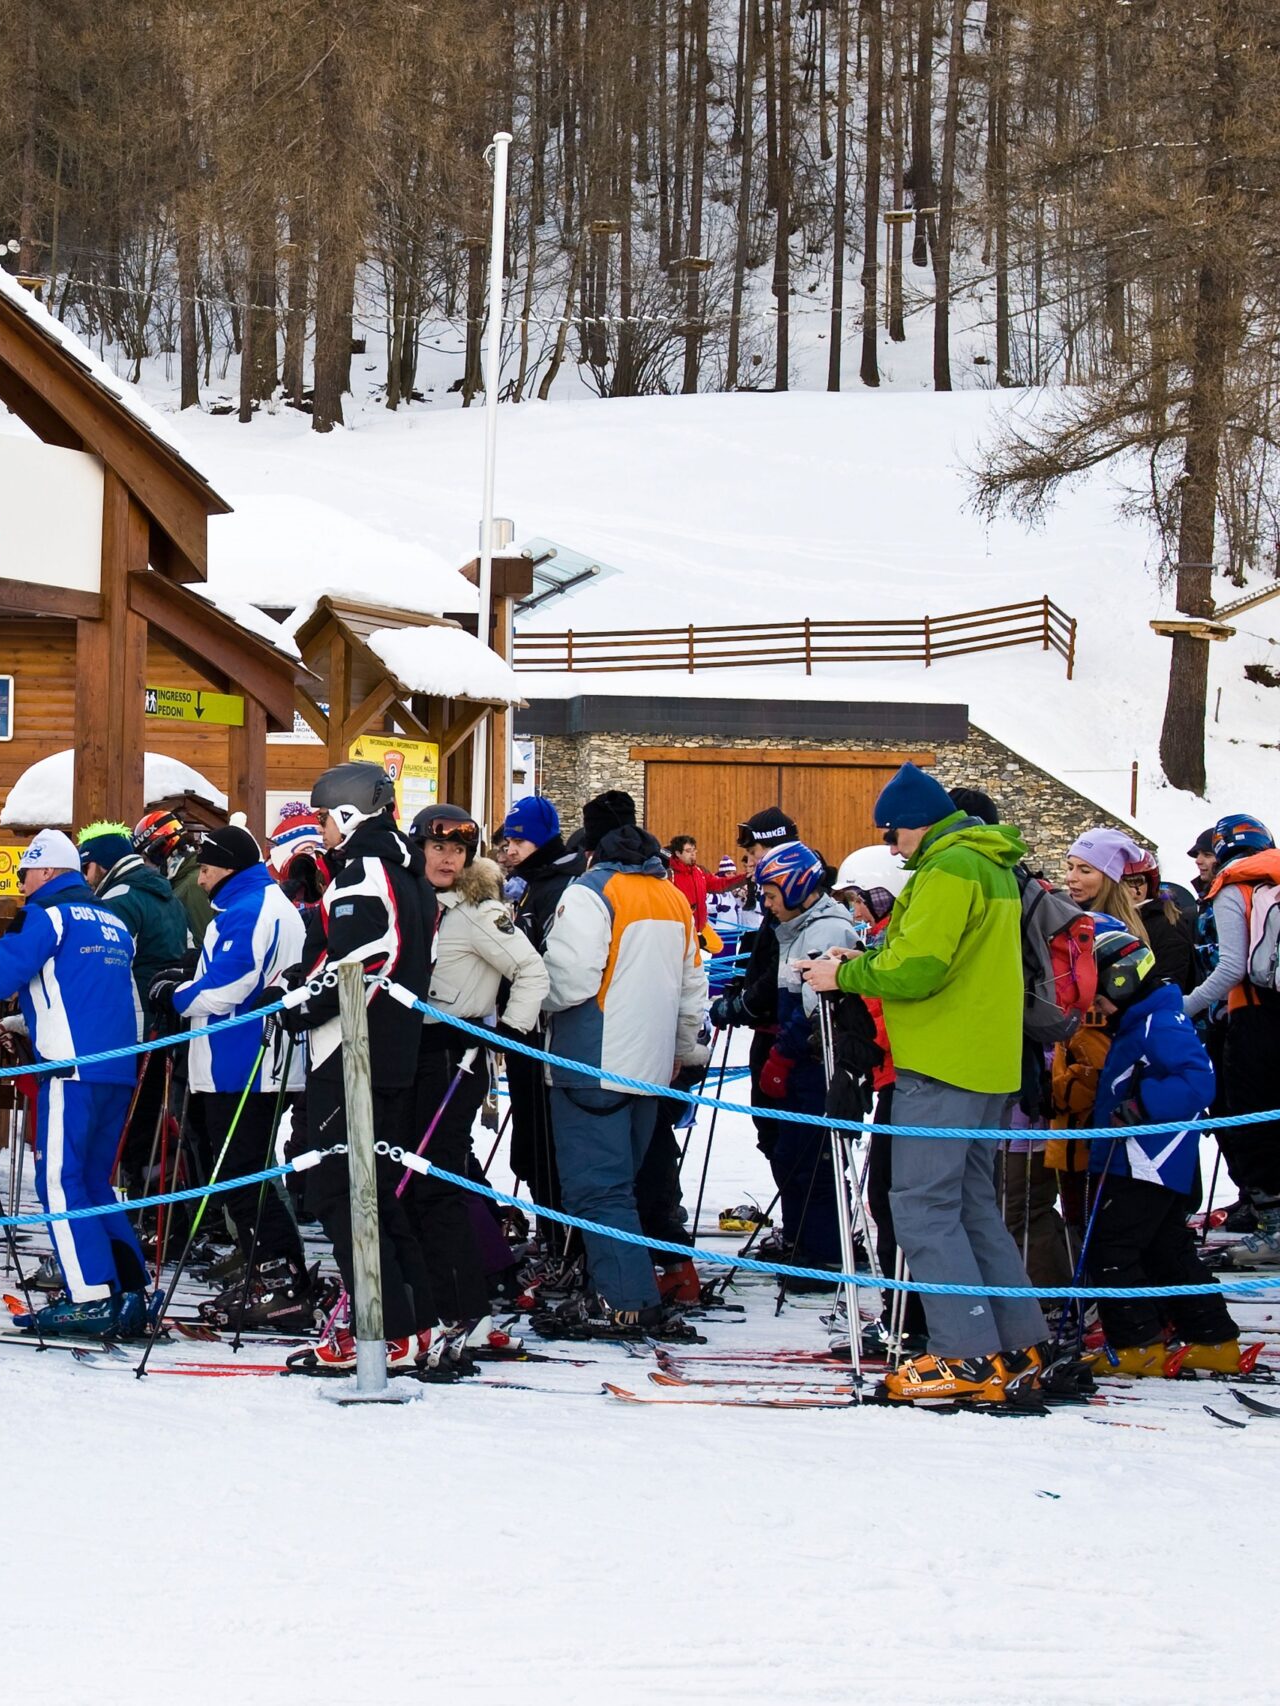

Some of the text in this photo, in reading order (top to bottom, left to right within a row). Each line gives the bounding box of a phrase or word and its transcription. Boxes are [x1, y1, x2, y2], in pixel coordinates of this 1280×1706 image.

[158, 689, 192, 703] INGRESSO
[158, 705, 184, 717] PEDONI
[390, 765, 396, 778] 3
[133, 824, 158, 847] uvex
[752, 826, 786, 840] MARKER
[70, 906, 96, 922] CUS
[101, 925, 120, 942] SCI
[902, 1382, 956, 1395] ROSSIGNOL
